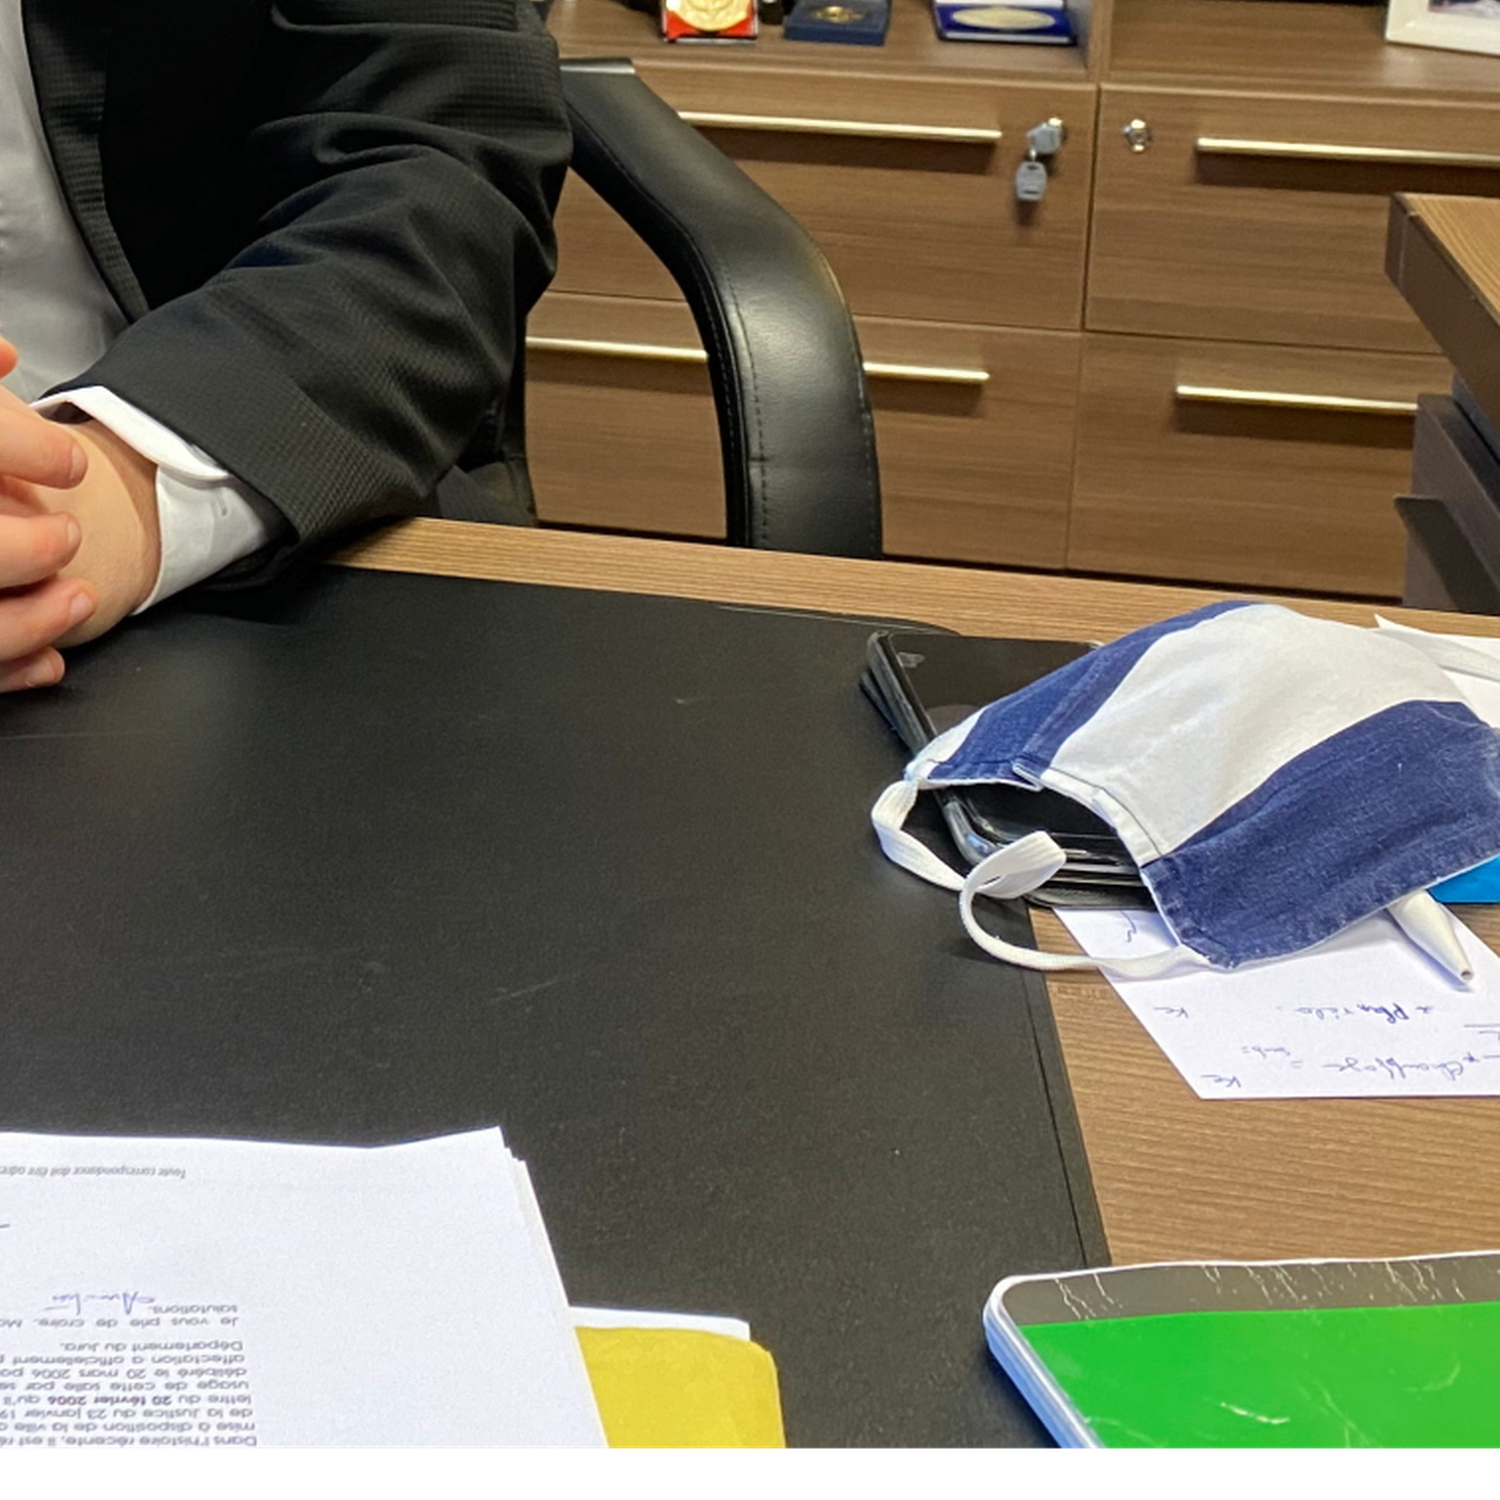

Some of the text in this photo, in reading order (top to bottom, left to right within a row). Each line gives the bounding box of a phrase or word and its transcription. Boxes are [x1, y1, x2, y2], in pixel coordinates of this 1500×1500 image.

[95, 1318, 119, 1329] de
[129, 1316, 161, 1329] prie
[171, 1318, 209, 1327] vous
[220, 1318, 239, 1329] Je
[104, 1342, 128, 1353] du
[131, 1340, 244, 1353] Département
[12, 1355, 125, 1366] officiellement
[131, 1355, 145, 1364] a
[151, 1355, 246, 1366] affectation
[31, 1368, 71, 1379] 2006
[78, 1368, 120, 1377] mars
[126, 1368, 147, 1379] 20
[154, 1368, 171, 1379] le
[177, 1368, 248, 1379] délibéré
[25, 1379, 56, 1391] par
[63, 1381, 101, 1393] salle
[109, 1381, 157, 1392] cette
[164, 1381, 189, 1392] de
[196, 1379, 250, 1390] usage
[47, 1395, 88, 1406] 2006
[93, 1395, 147, 1406] février
[151, 1395, 173, 1406] 20
[178, 1395, 202, 1406] du
[208, 1395, 252, 1406] lettre
[24, 1406, 82, 1420] janvier
[86, 1409, 108, 1420] 23
[113, 1409, 137, 1420] du
[140, 1409, 201, 1420] Justice
[207, 1409, 224, 1420] la
[229, 1409, 254, 1420] de
[14, 1422, 47, 1433] ville
[51, 1422, 69, 1433] la
[73, 1422, 99, 1433] de
[103, 1420, 194, 1433] disposition
[198, 1422, 212, 1433] à
[216, 1423, 256, 1434] mise
[18, 1436, 44, 1447] est
[47, 1436, 57, 1447] il
[213, 1436, 258, 1447] Dans
